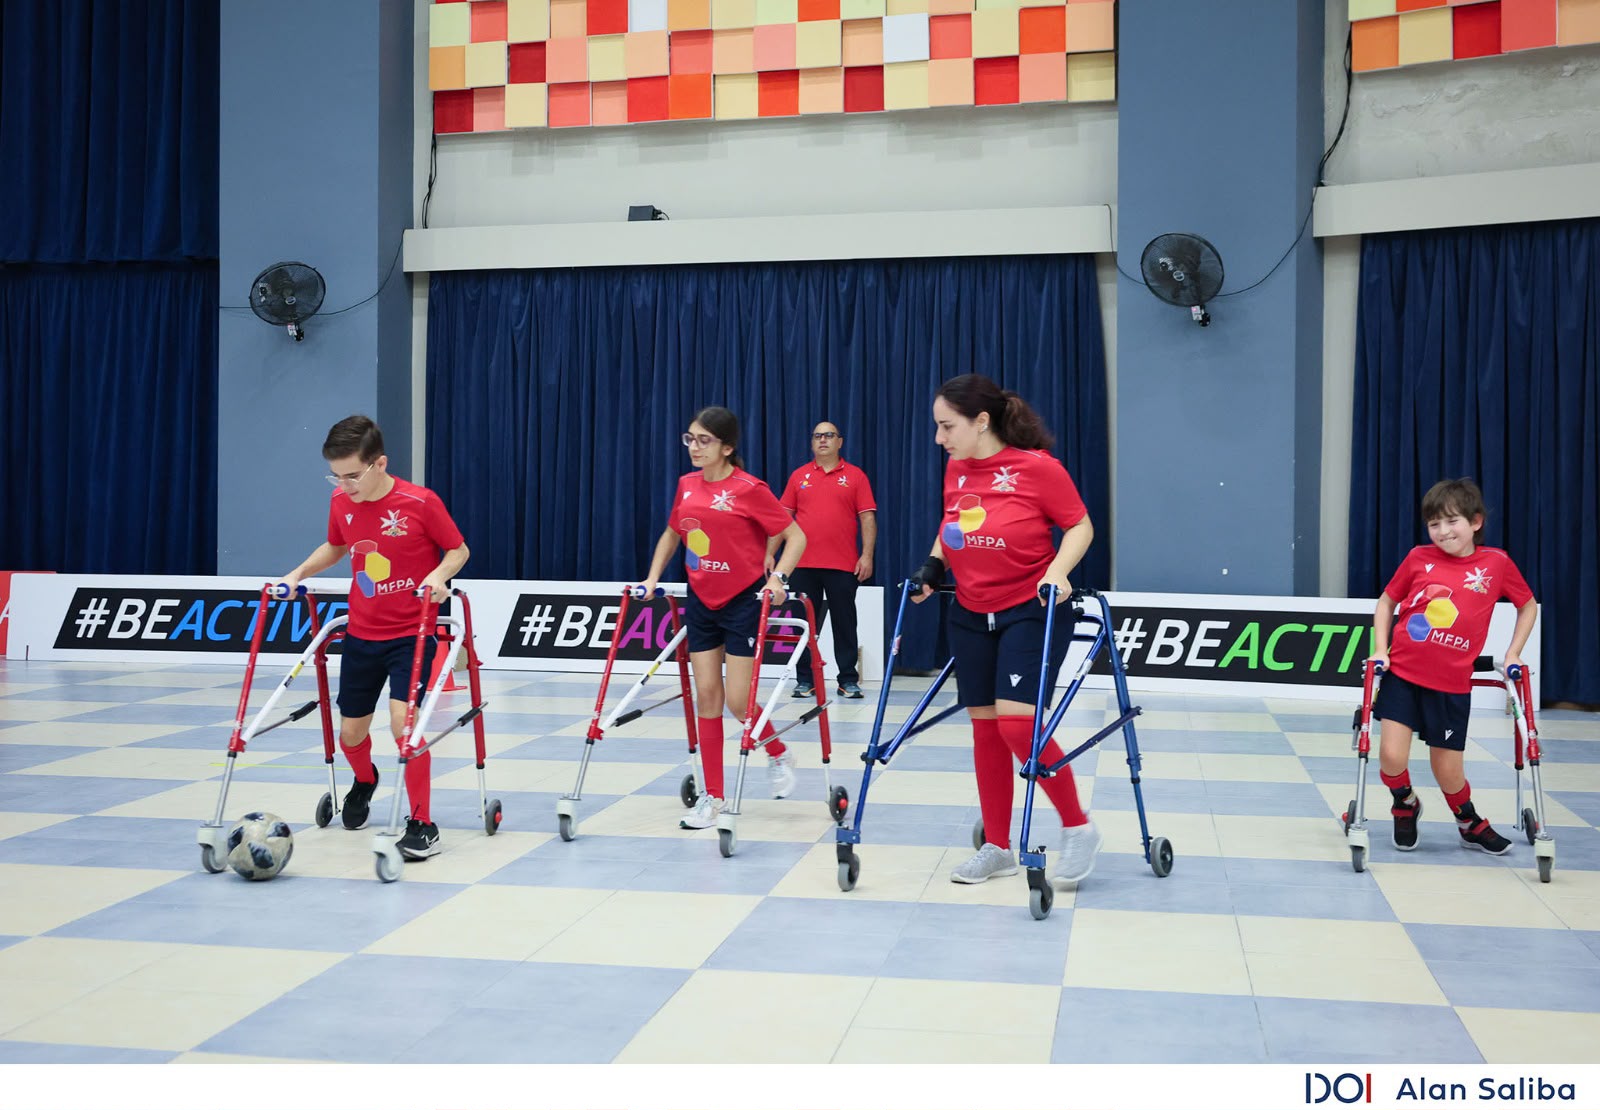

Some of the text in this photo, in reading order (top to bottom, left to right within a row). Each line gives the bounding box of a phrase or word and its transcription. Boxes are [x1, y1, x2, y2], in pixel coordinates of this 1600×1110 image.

[965, 535, 1006, 548] MFPA
[377, 577, 415, 593] MFPA
[1431, 630, 1470, 650] MFPA
